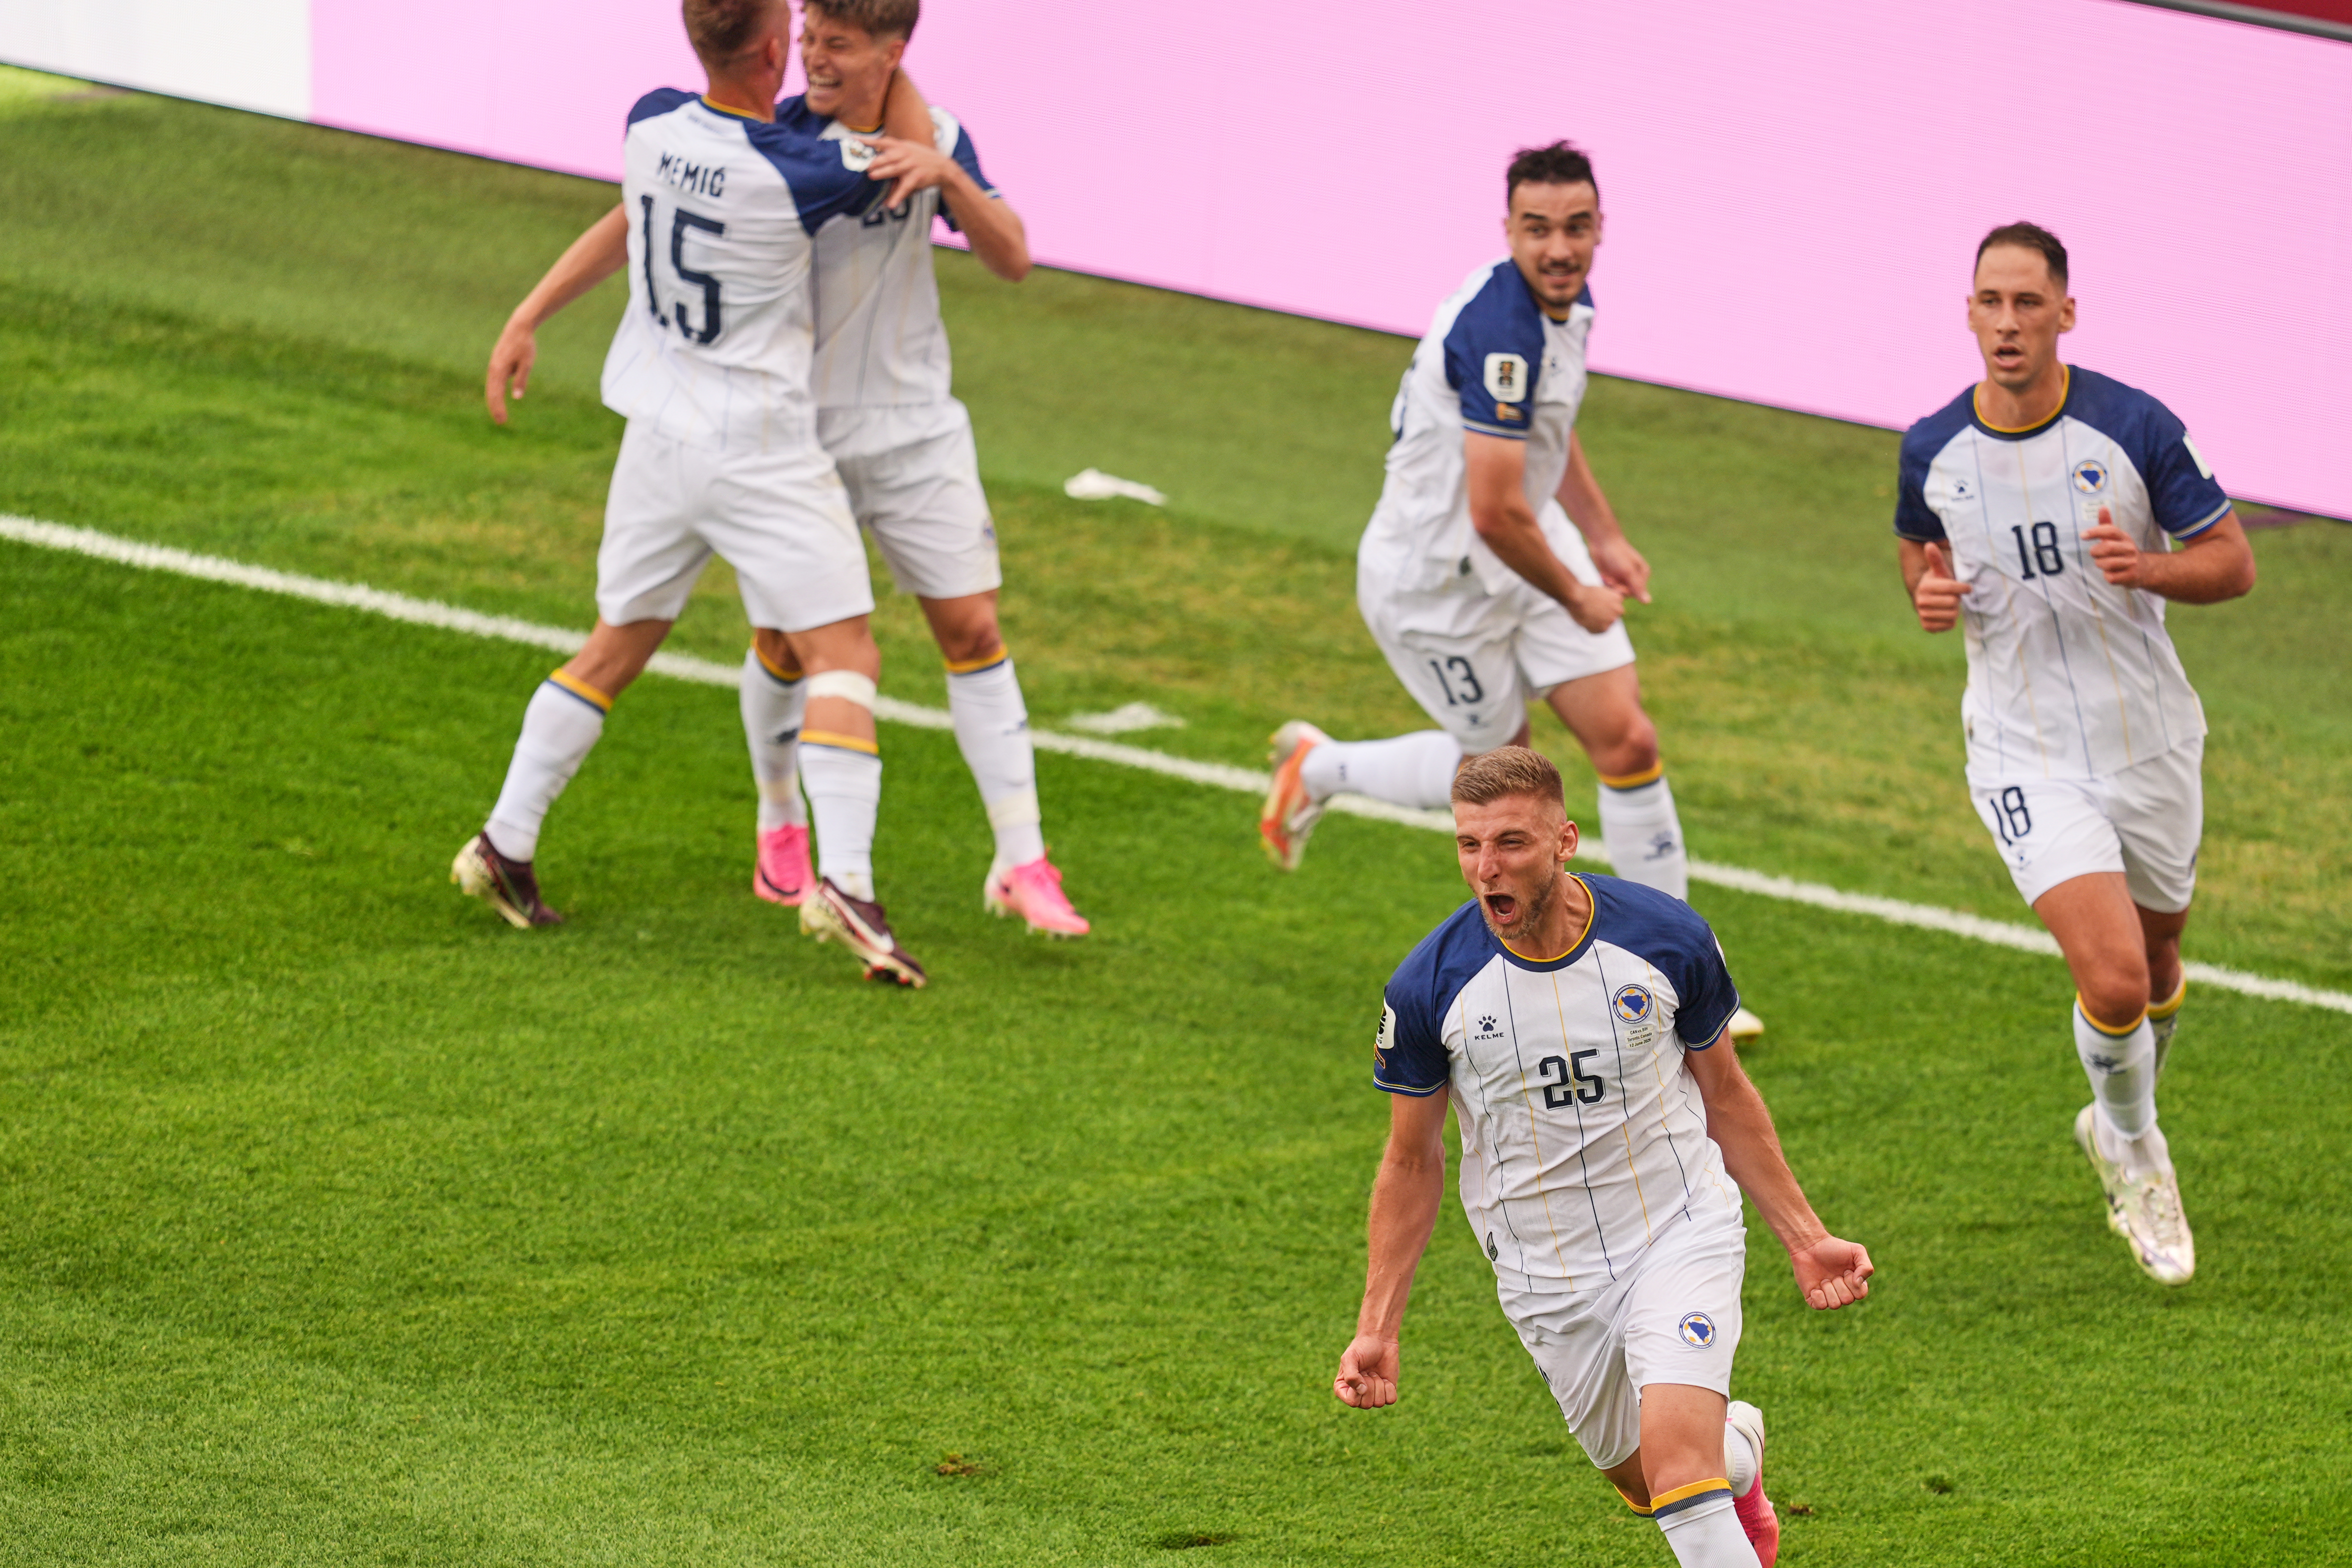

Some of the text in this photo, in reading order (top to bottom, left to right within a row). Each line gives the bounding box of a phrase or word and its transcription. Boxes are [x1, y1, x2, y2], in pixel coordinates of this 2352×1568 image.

[641, 194, 726, 346] 15
[2012, 522, 2064, 580] 18
[1430, 656, 1484, 705] 13
[1990, 786, 2032, 847] 18
[1474, 1032, 1504, 1040] KELME
[1538, 1048, 1606, 1110] 25
